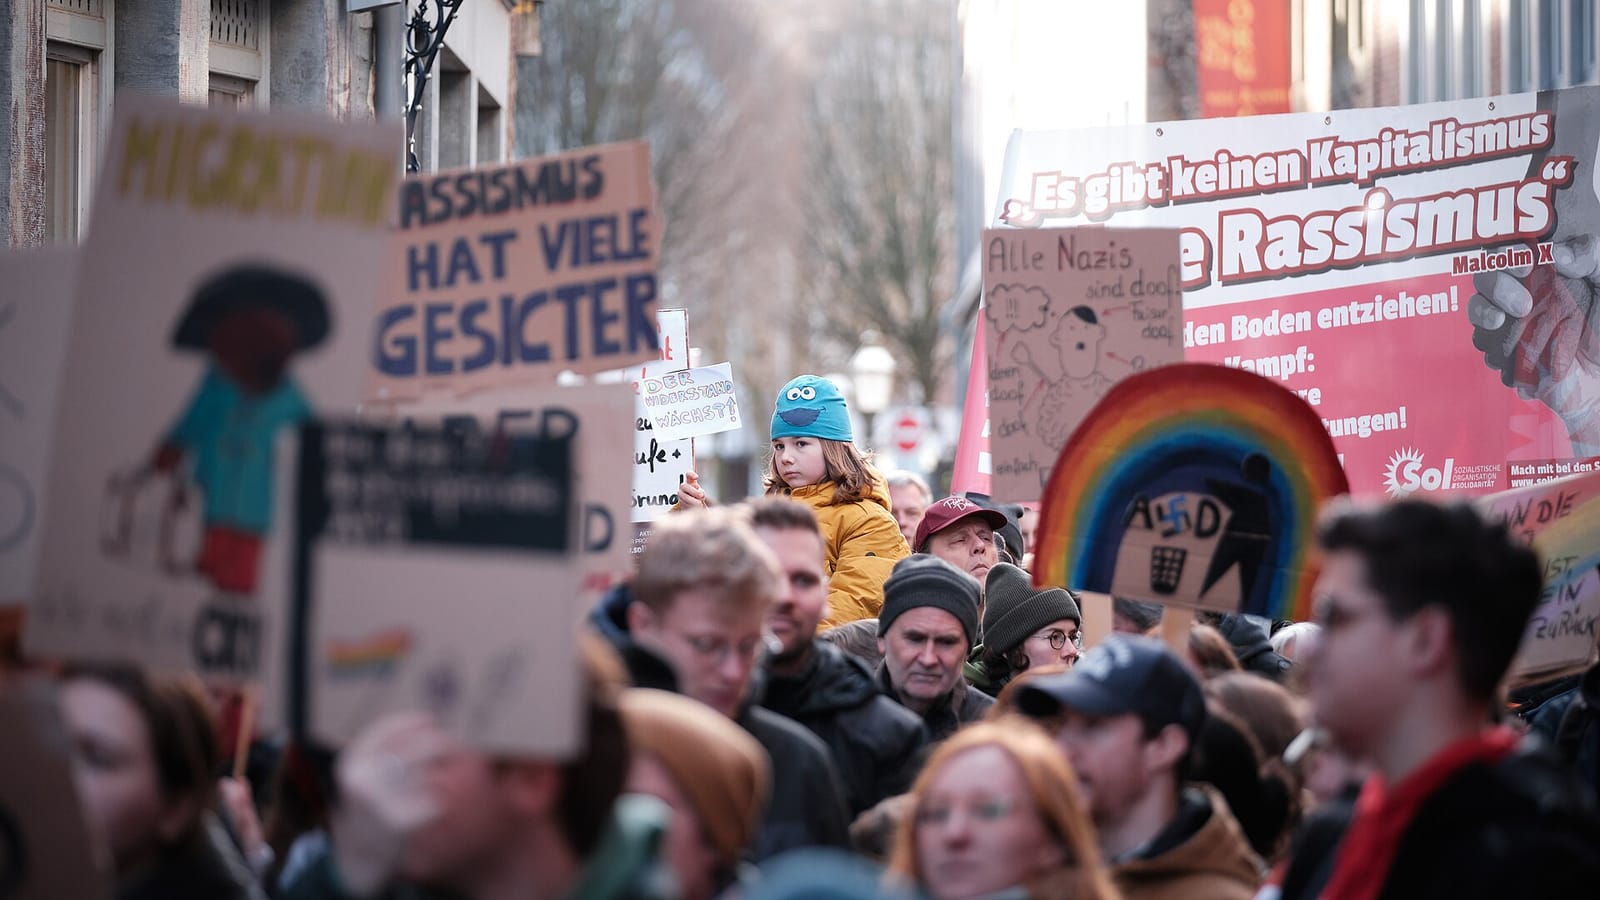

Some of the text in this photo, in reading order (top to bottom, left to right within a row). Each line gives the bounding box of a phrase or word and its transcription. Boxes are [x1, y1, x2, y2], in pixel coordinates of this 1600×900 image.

[1084, 162, 1166, 220] gibt
[1168, 149, 1304, 202] keinen
[1307, 112, 1552, 182] Kapitalismus
[399, 154, 604, 229] ASSISMUS
[1218, 157, 1573, 280] Rassismus“
[407, 208, 649, 292] HAT VIELE
[988, 234, 1132, 272] Alle Nazis
[1451, 243, 1554, 276] Malcolm X
[1086, 274, 1124, 298] sind
[371, 273, 660, 378] GESICTER
[1231, 309, 1312, 341] Boden
[1317, 286, 1459, 328] entziehen!
[644, 371, 694, 394] DER
[645, 380, 734, 407] WIDERSTAND
[655, 396, 737, 428] WÄCHST!
[633, 438, 667, 473] ufe
[1454, 464, 1501, 474] SOZIALISTISCHE
[1511, 460, 1600, 476] Mach mit bei den S
[1402, 458, 1454, 492] Sol
[1453, 472, 1497, 482] ORGANISATION
[1537, 490, 1580, 524] DIE
